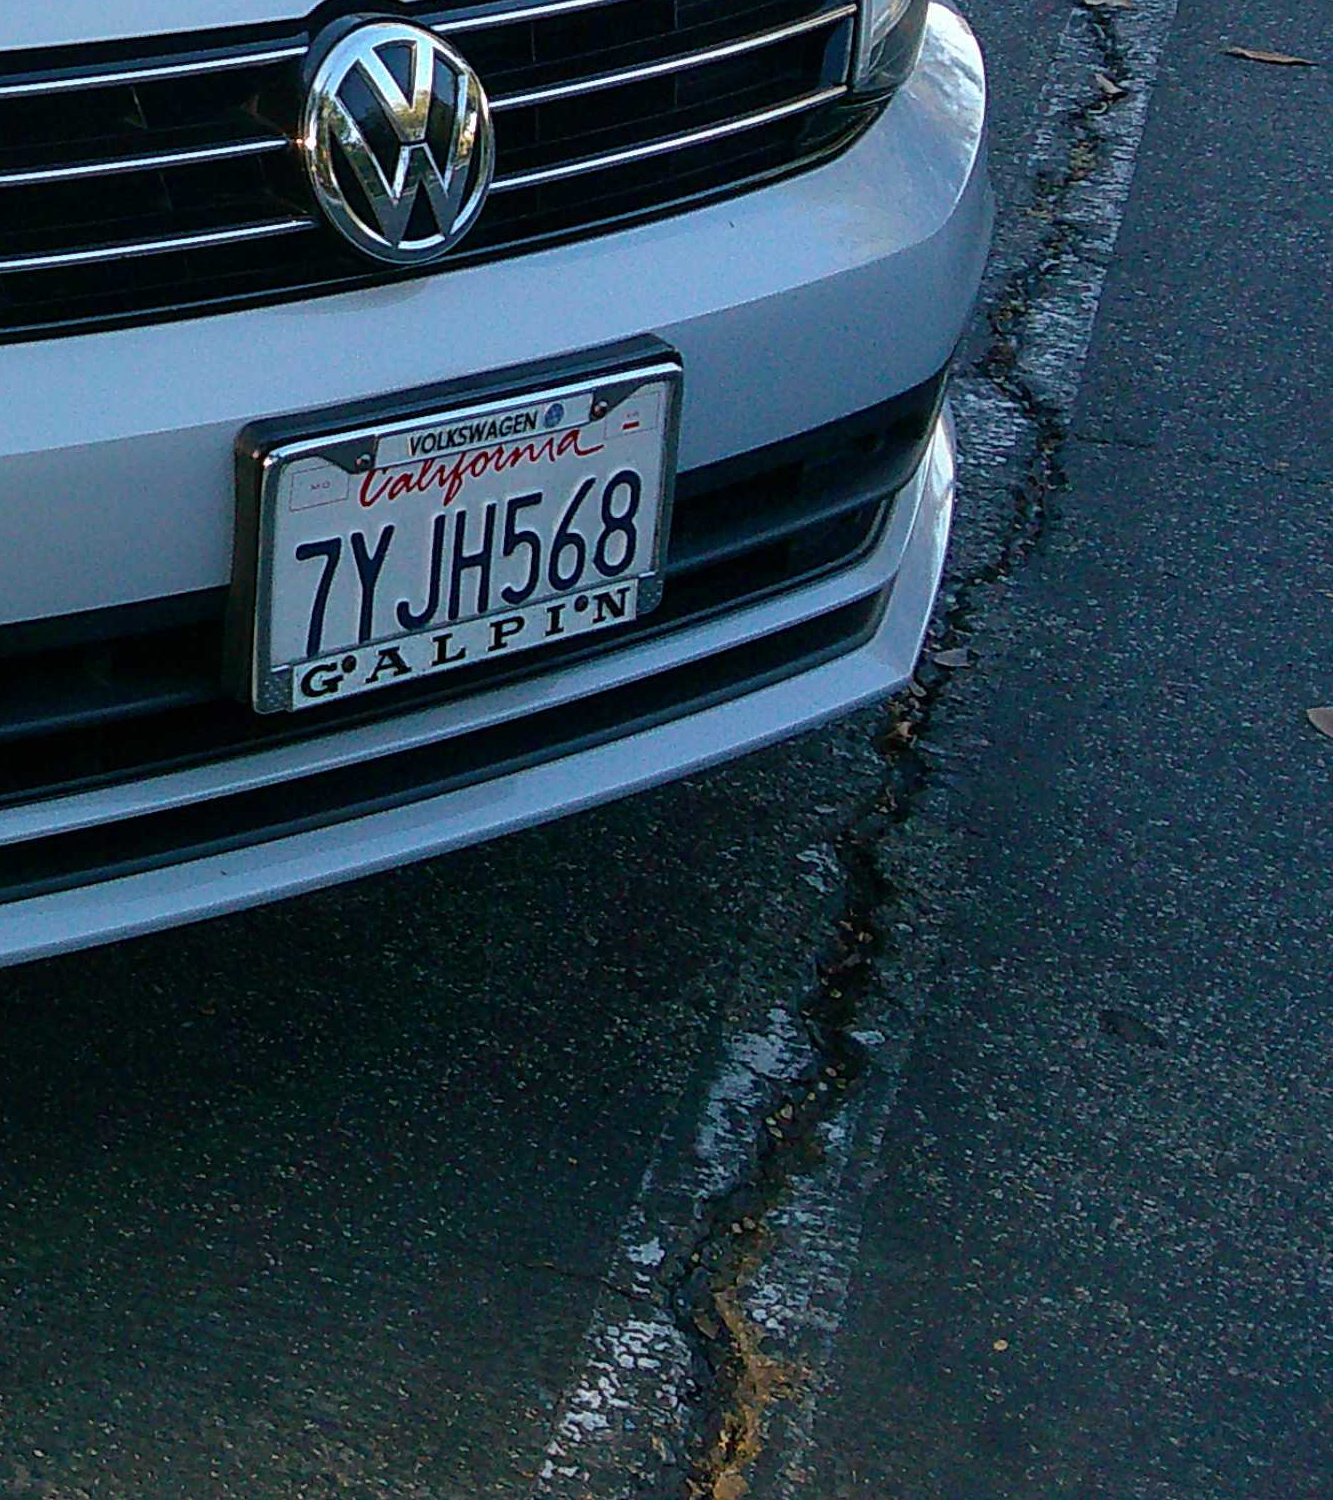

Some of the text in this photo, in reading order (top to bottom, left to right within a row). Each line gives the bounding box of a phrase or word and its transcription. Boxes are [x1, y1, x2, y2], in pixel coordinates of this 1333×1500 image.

[359, 429, 604, 508] California
[406, 409, 539, 457] VOLKSWAGEN
[295, 470, 643, 658] 7YJH568
[299, 585, 631, 699] GALPIN
